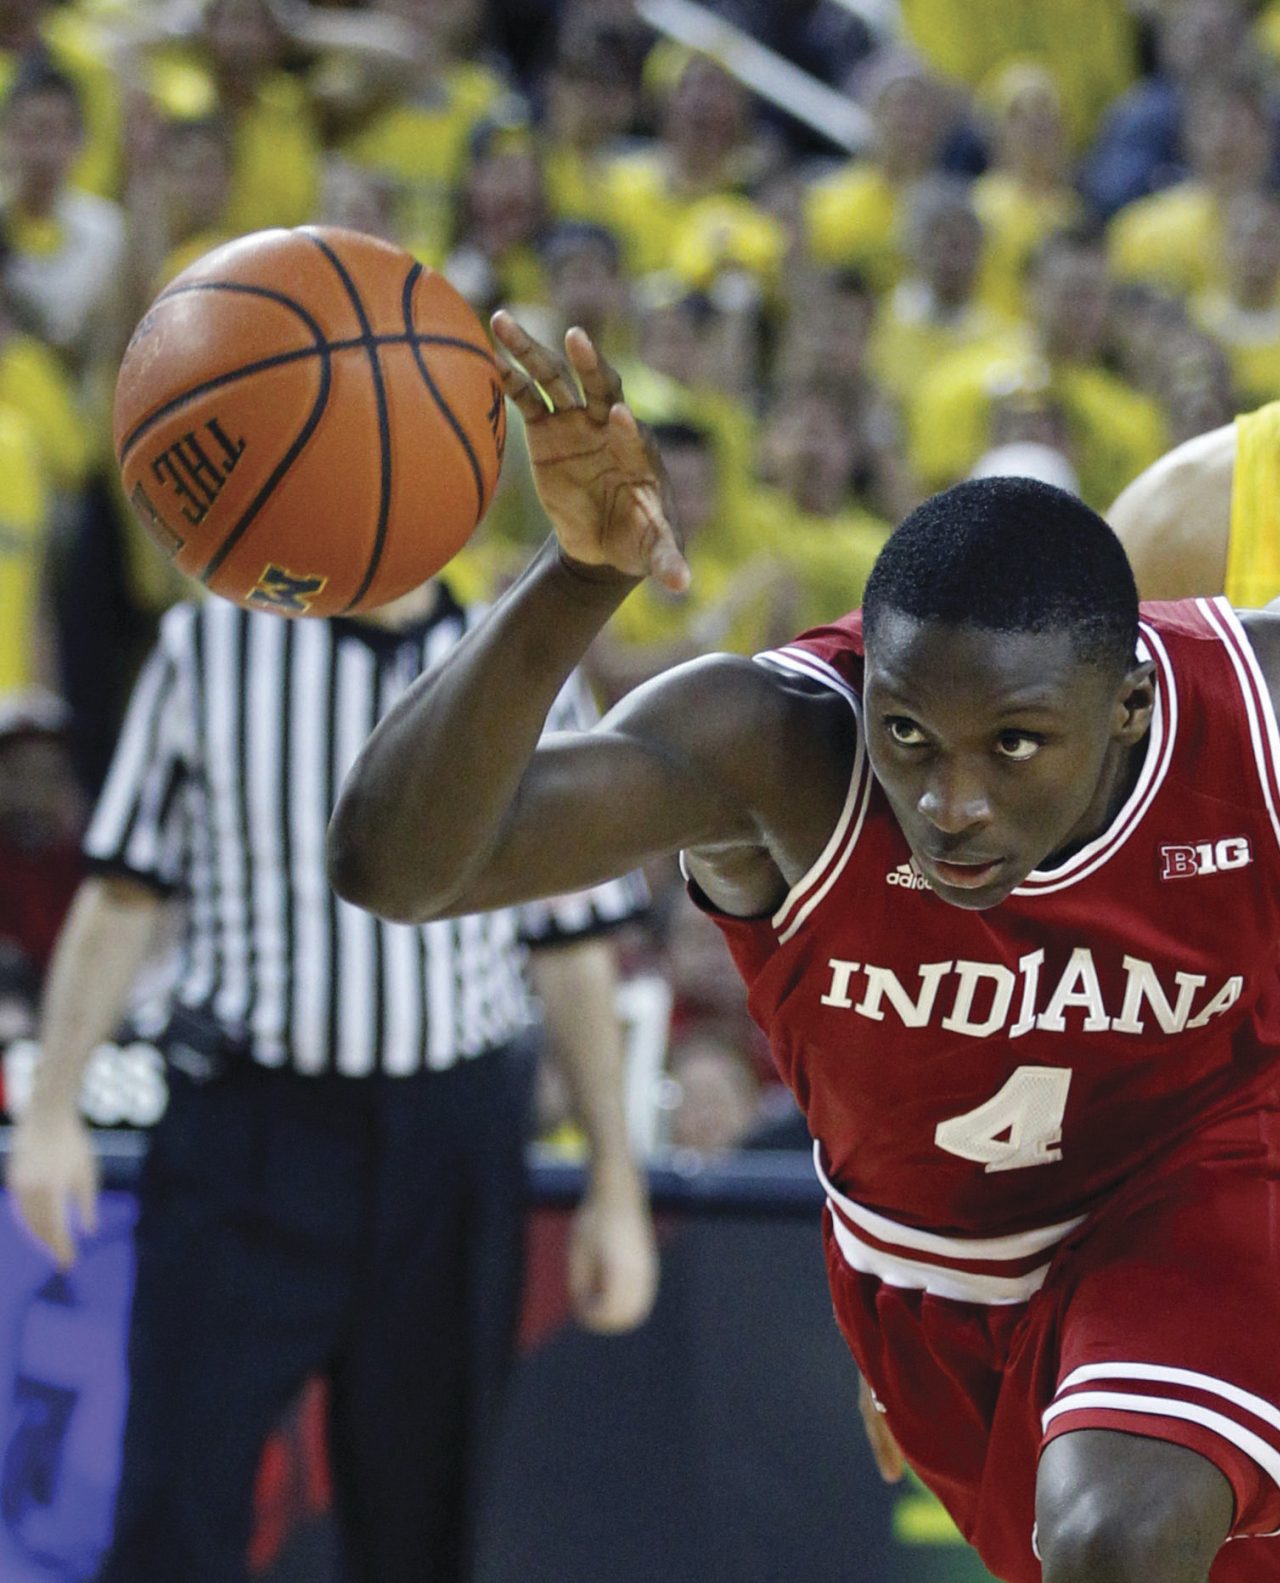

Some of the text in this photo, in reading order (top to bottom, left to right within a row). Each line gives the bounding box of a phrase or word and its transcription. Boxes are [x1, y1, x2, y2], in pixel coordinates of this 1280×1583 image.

[154, 418, 246, 525] THE
[821, 947, 1244, 1039] INDIANA
[934, 1066, 1073, 1173] 4
